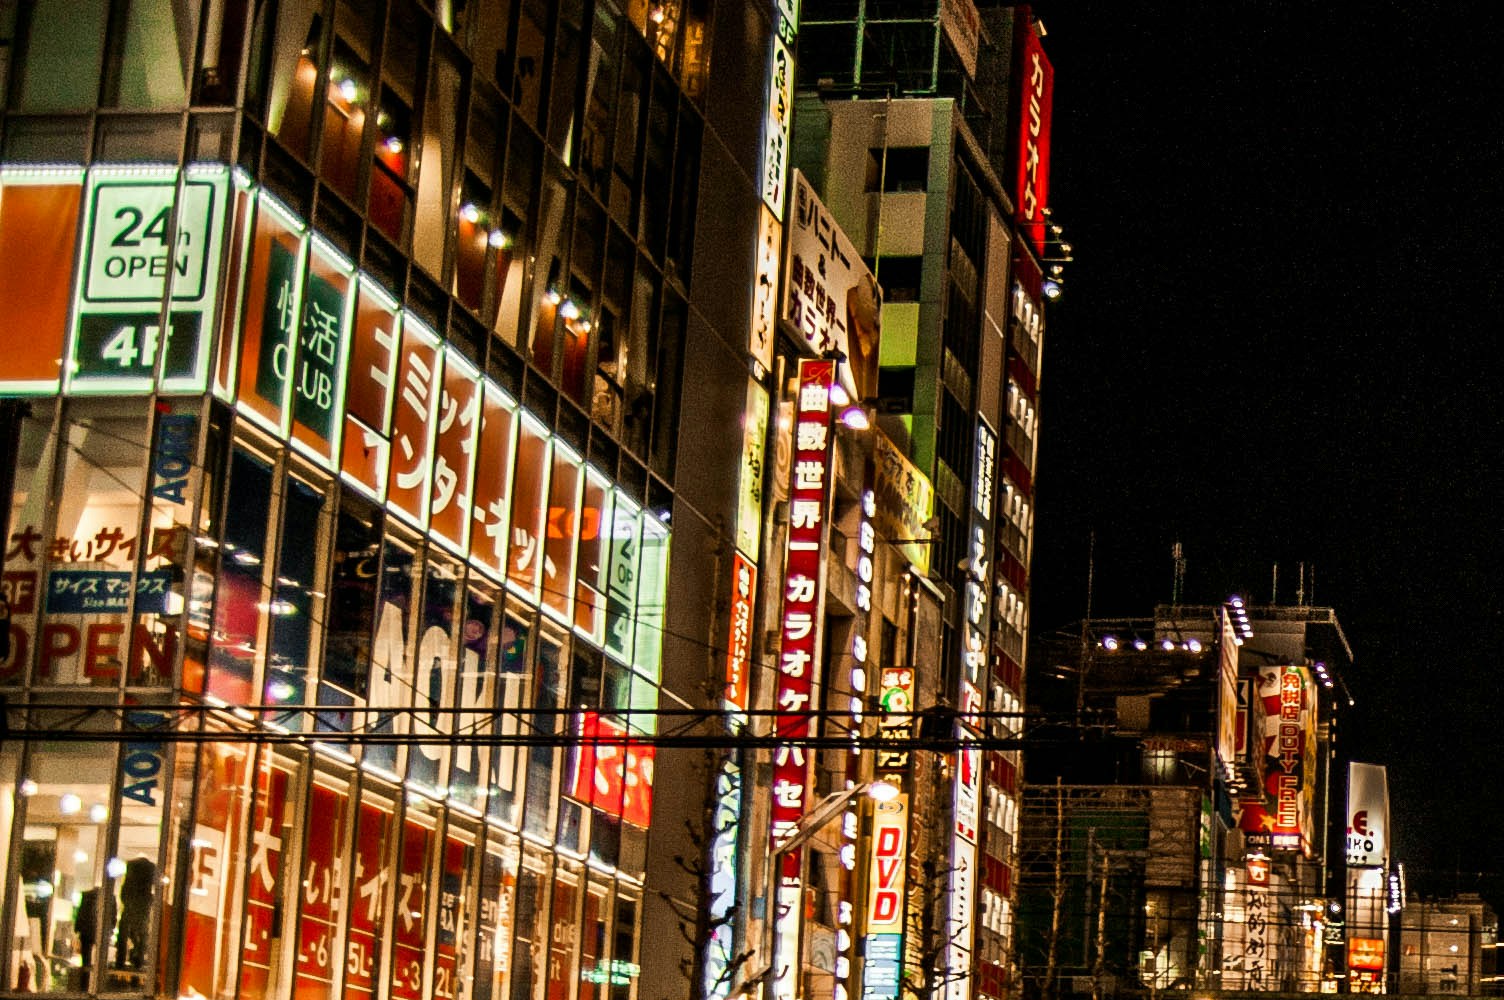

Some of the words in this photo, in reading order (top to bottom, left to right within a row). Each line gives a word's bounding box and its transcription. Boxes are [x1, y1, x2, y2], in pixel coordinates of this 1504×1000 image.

[105, 254, 189, 281] OPEN
[102, 324, 174, 368] 4F
[1279, 723, 1301, 774] DUTY
[1276, 775, 1298, 828] FREE
[872, 826, 902, 925] DVD
